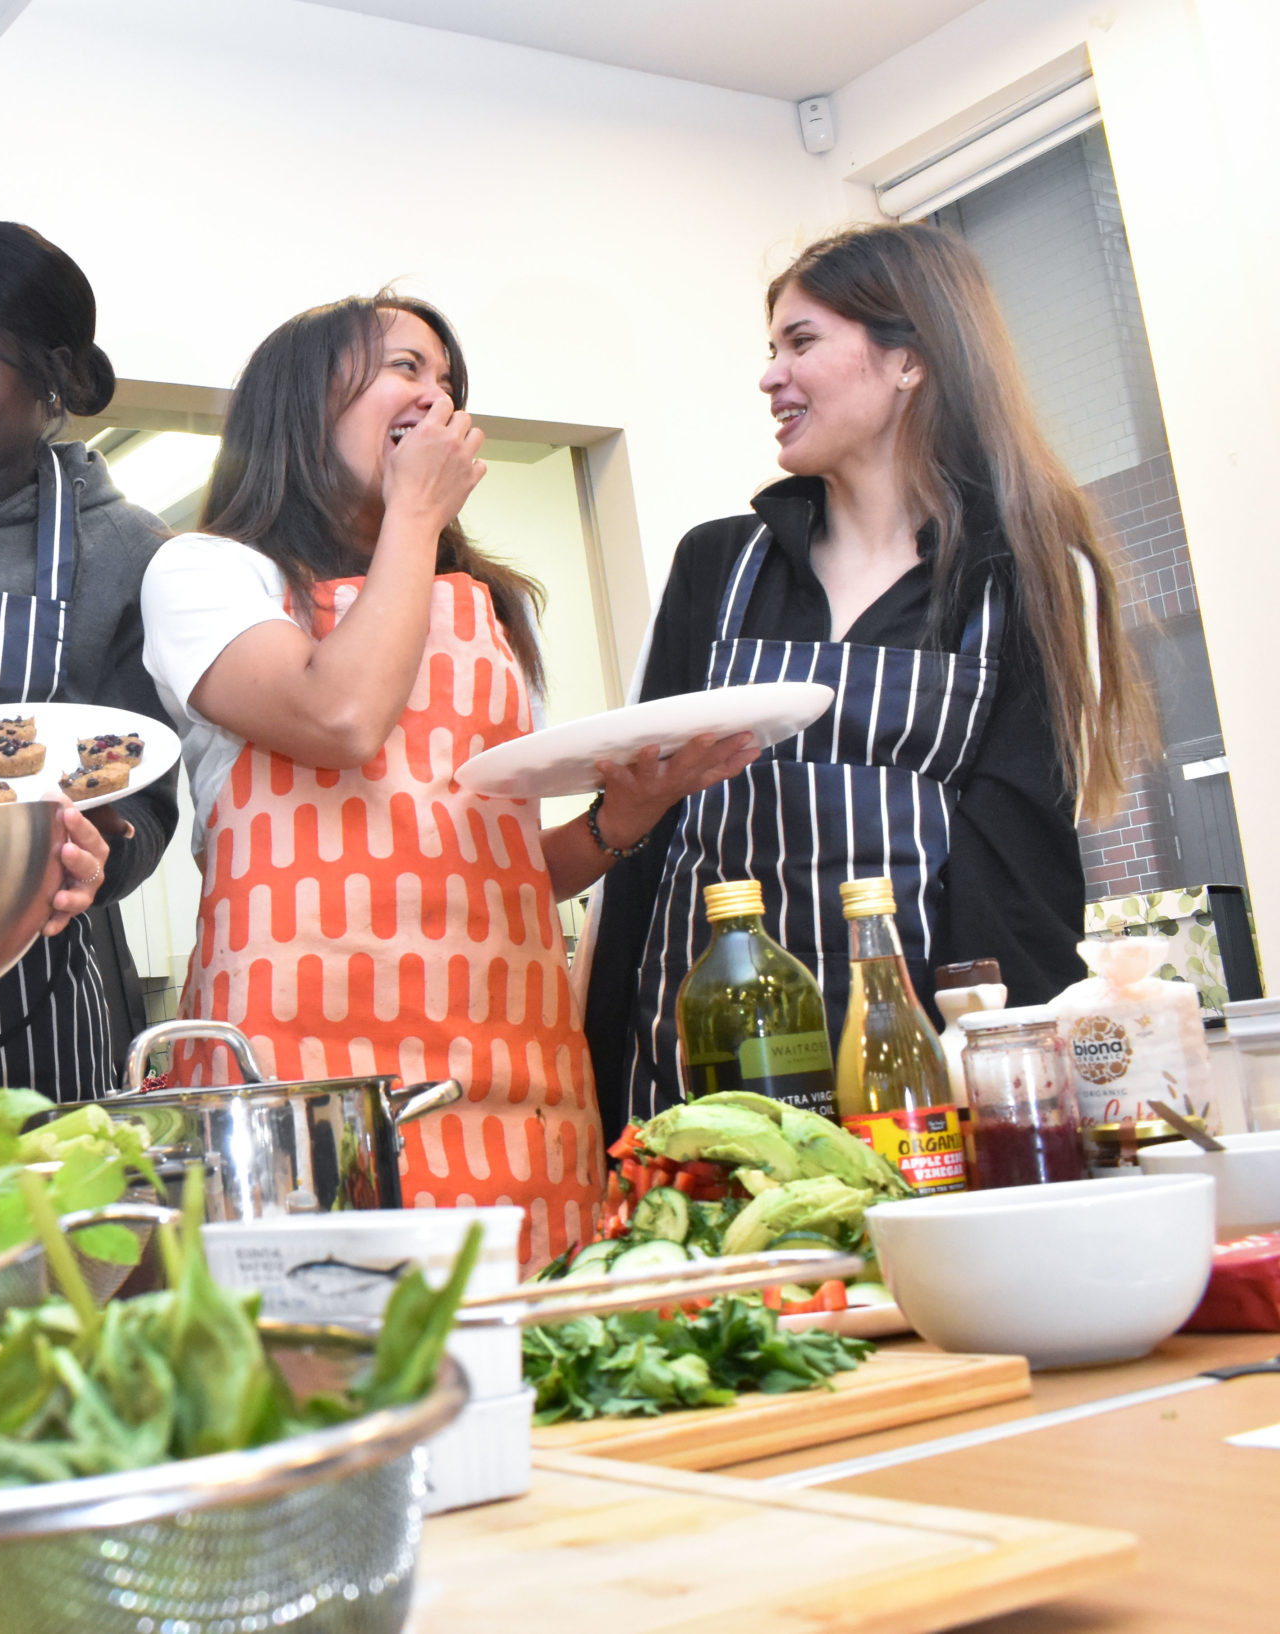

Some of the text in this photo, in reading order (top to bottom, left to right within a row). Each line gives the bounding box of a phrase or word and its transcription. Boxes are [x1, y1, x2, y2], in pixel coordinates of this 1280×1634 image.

[1072, 1040, 1123, 1057] biona
[1077, 1053, 1122, 1063] ORGANIC
[1082, 1087, 1128, 1099] ORGANIC
[773, 1094, 809, 1106] XTRA
[819, 1104, 835, 1116] OIL
[901, 1154, 942, 1170] APPLE
